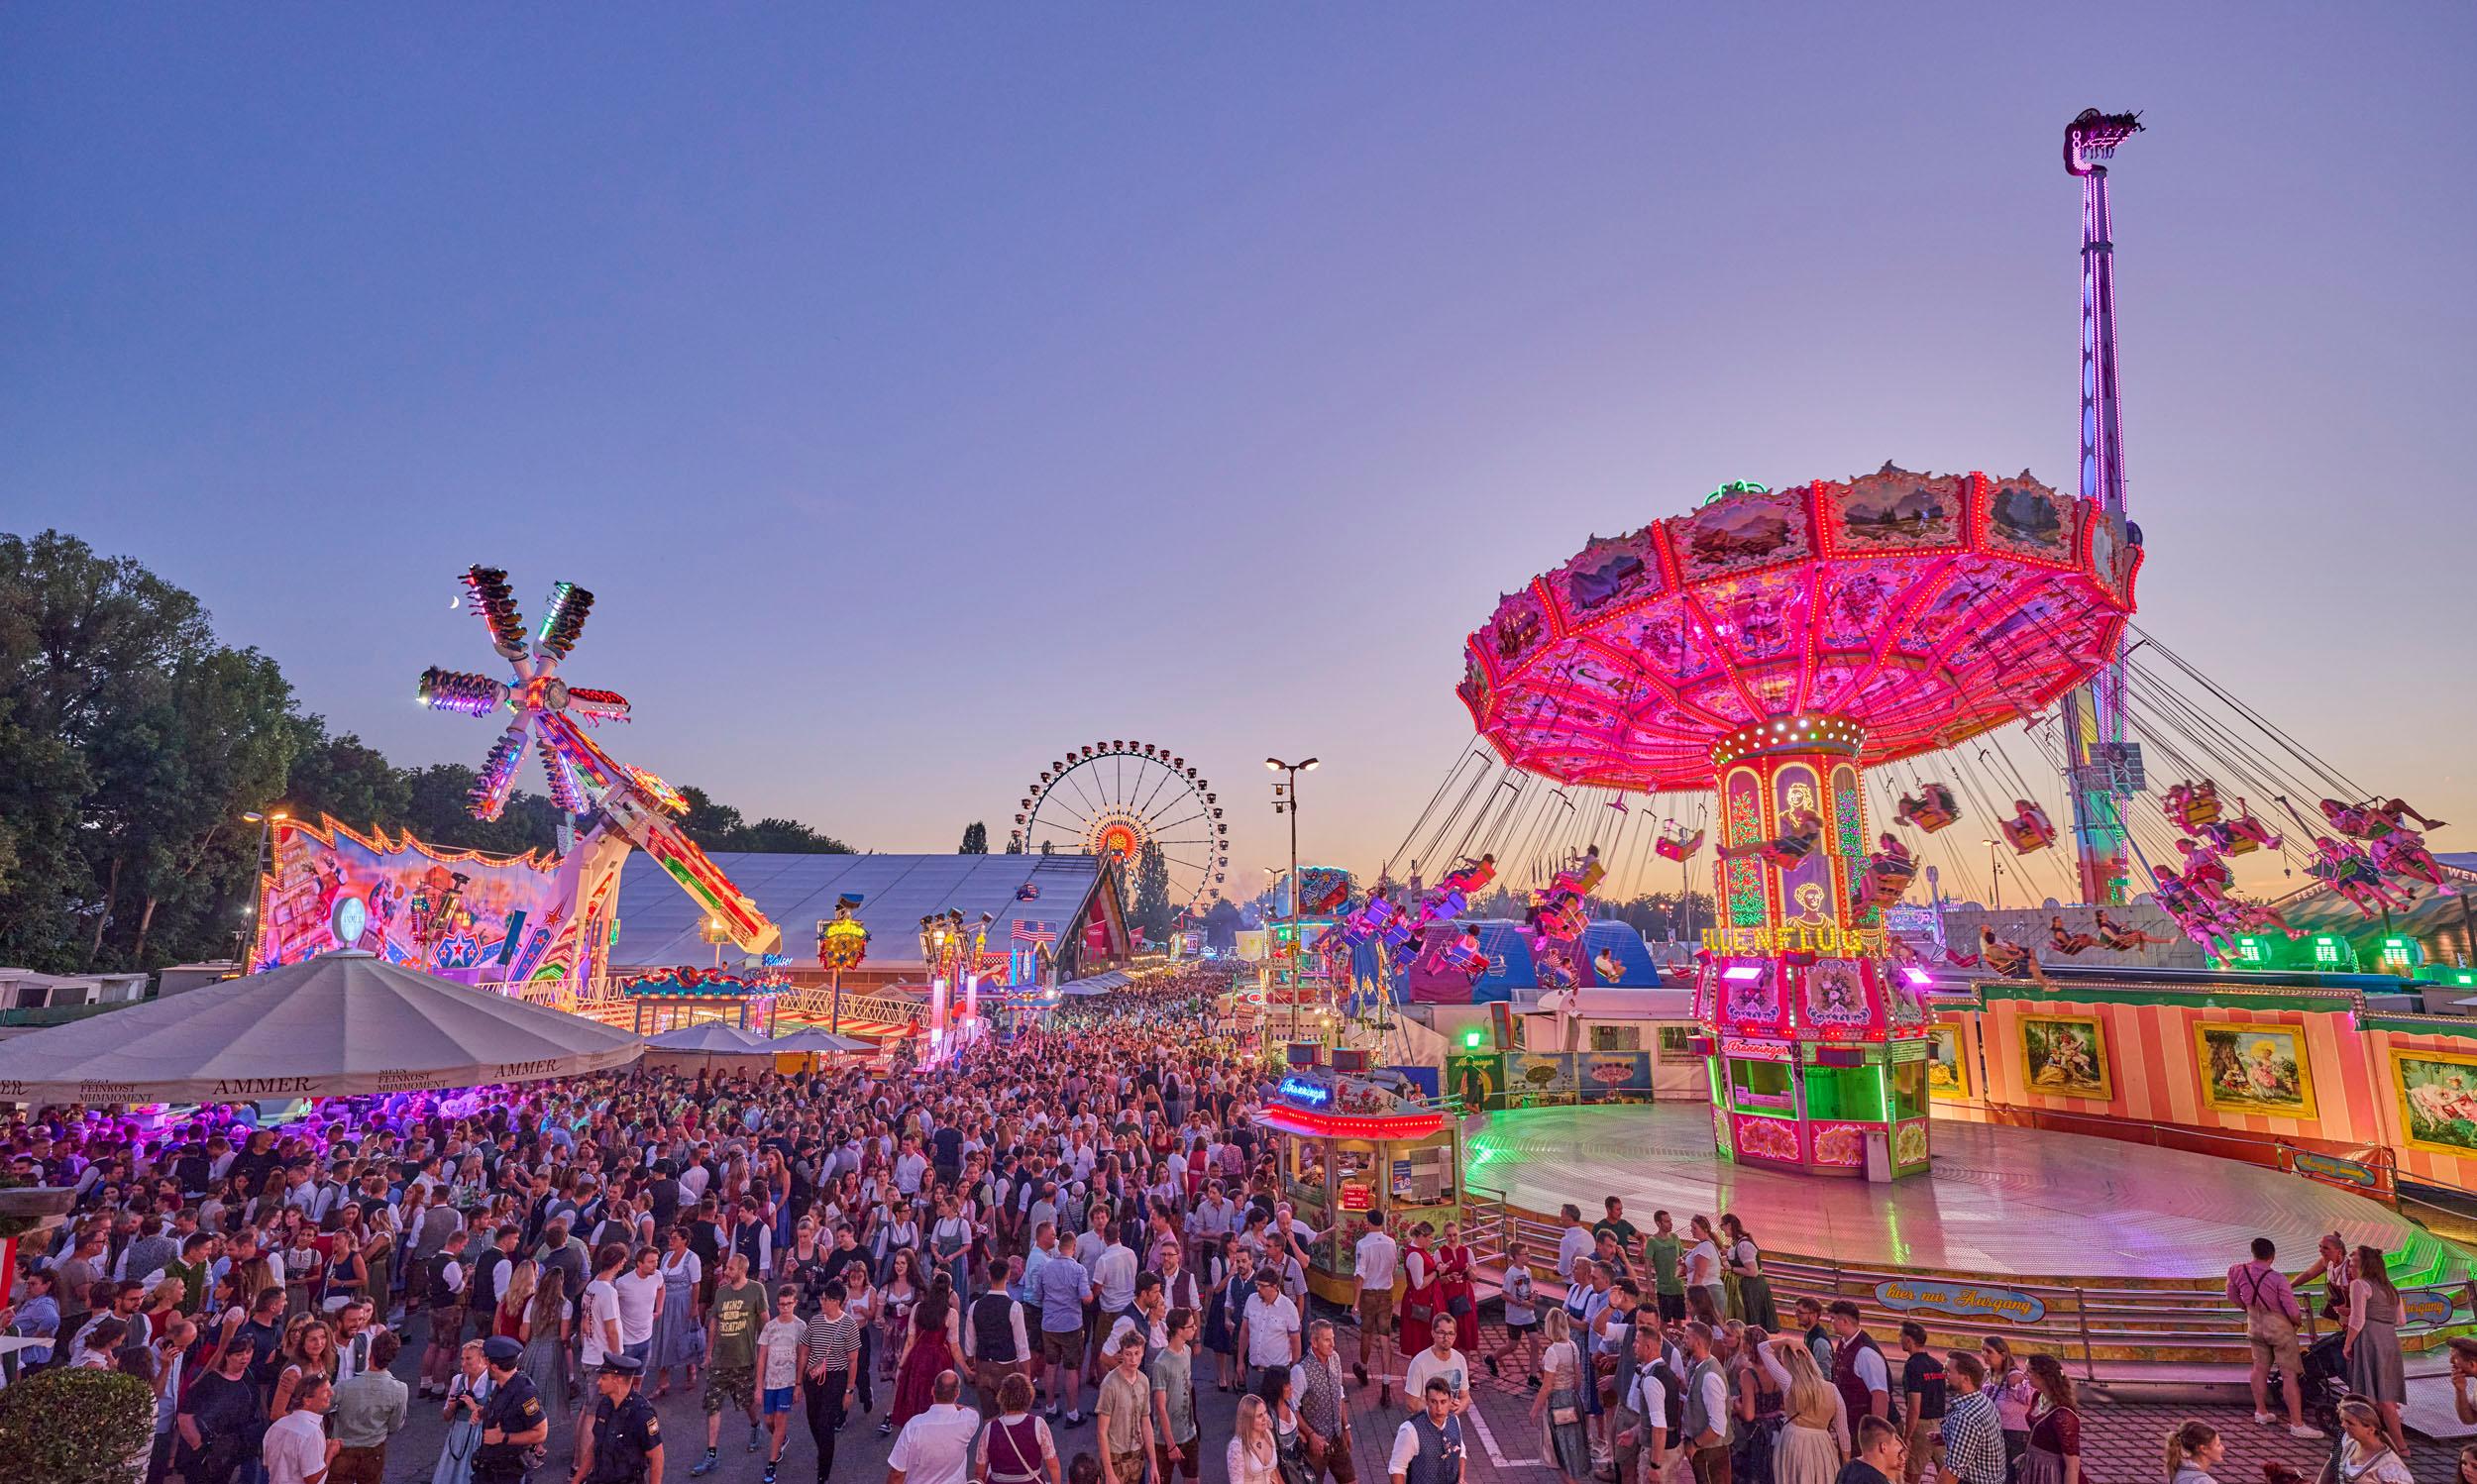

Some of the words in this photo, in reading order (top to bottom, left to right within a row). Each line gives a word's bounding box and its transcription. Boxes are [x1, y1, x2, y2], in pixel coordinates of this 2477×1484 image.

[765, 952, 793, 966] Kaiser
[493, 1059, 563, 1079] AMMER
[213, 1076, 322, 1095] AMMER
[378, 1072, 432, 1084] FEINKOST
[80, 1084, 137, 1093] FEINKOST
[1885, 1284, 1915, 1301] hier
[1920, 1291, 1947, 1303] nur
[1954, 1289, 2032, 1316] Ausgang
